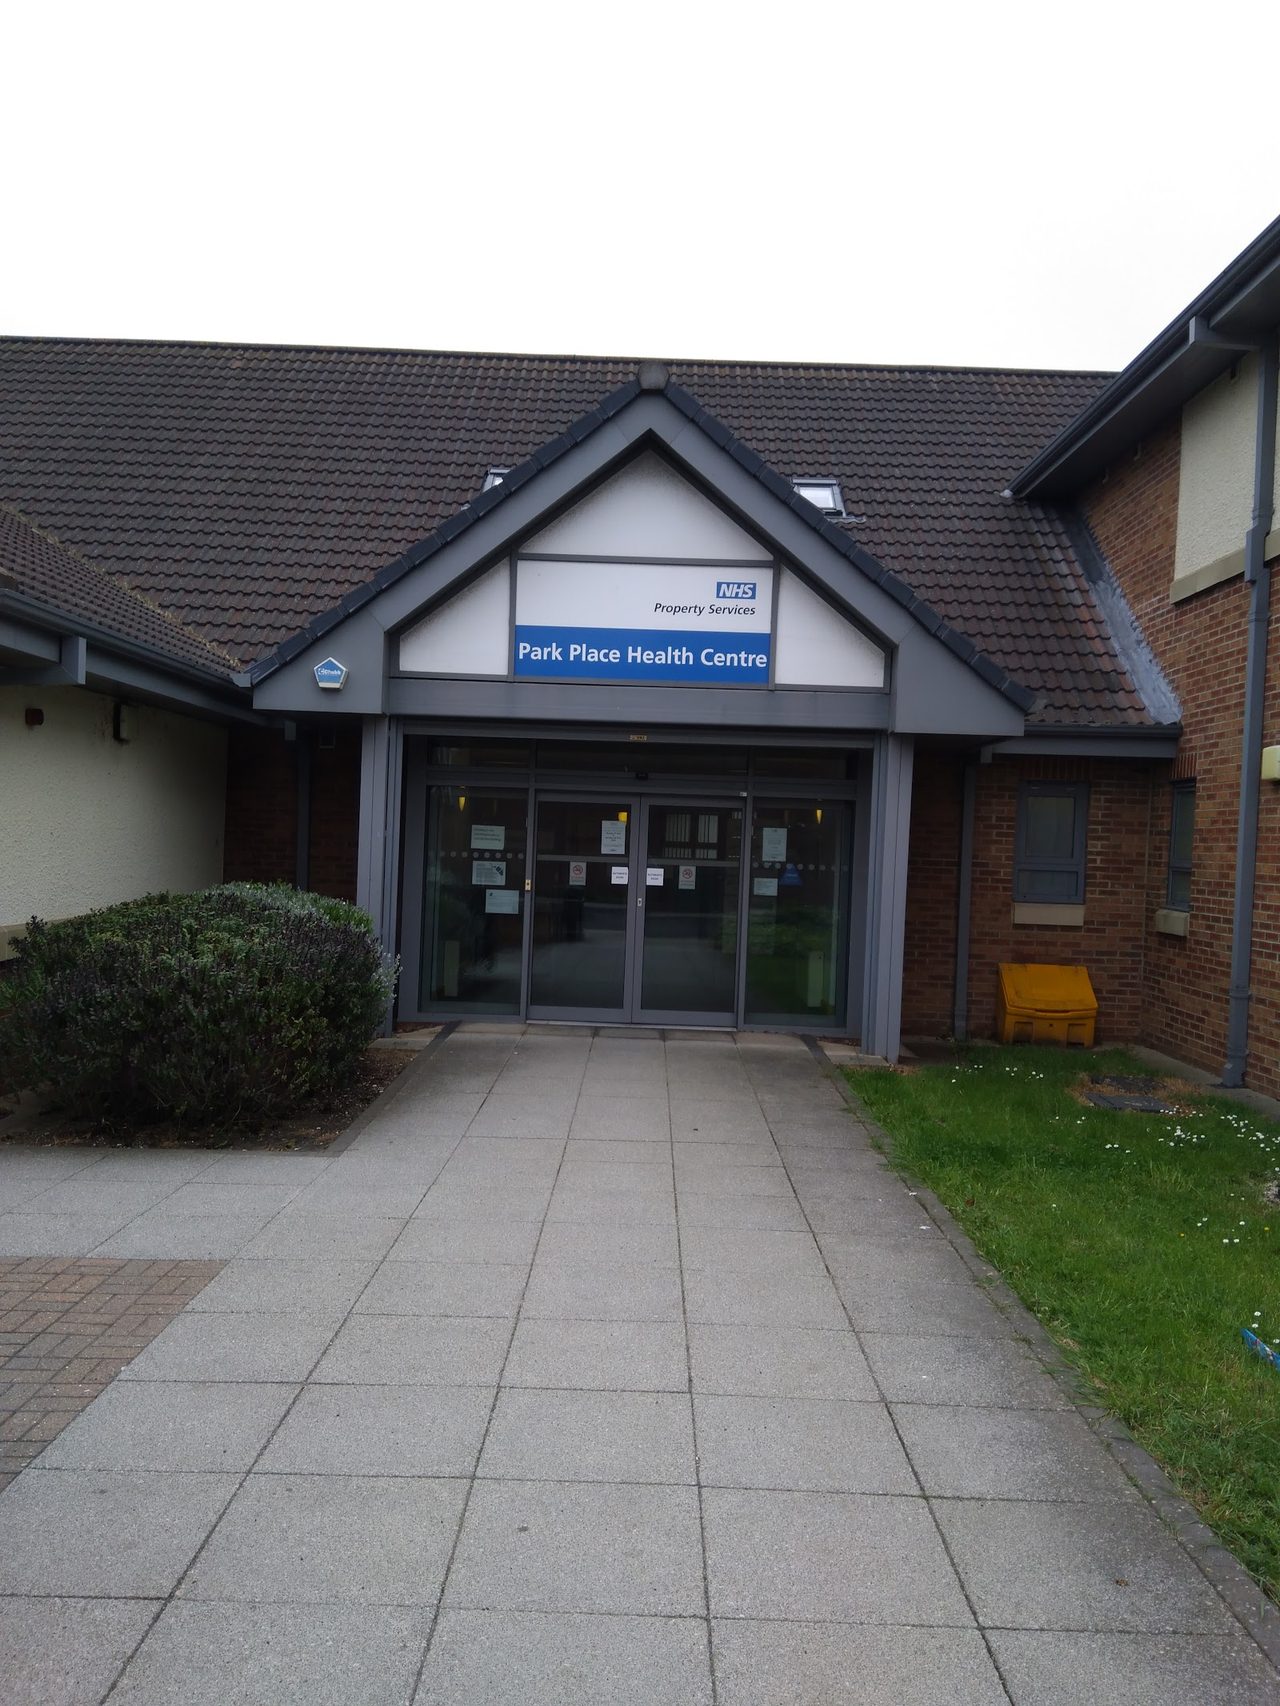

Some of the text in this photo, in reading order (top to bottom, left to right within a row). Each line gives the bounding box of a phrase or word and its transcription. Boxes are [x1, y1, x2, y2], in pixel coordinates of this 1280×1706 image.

[718, 583, 754, 598] NHS
[655, 602, 756, 617] Property Services
[518, 642, 768, 668] Park Place Health Centre
